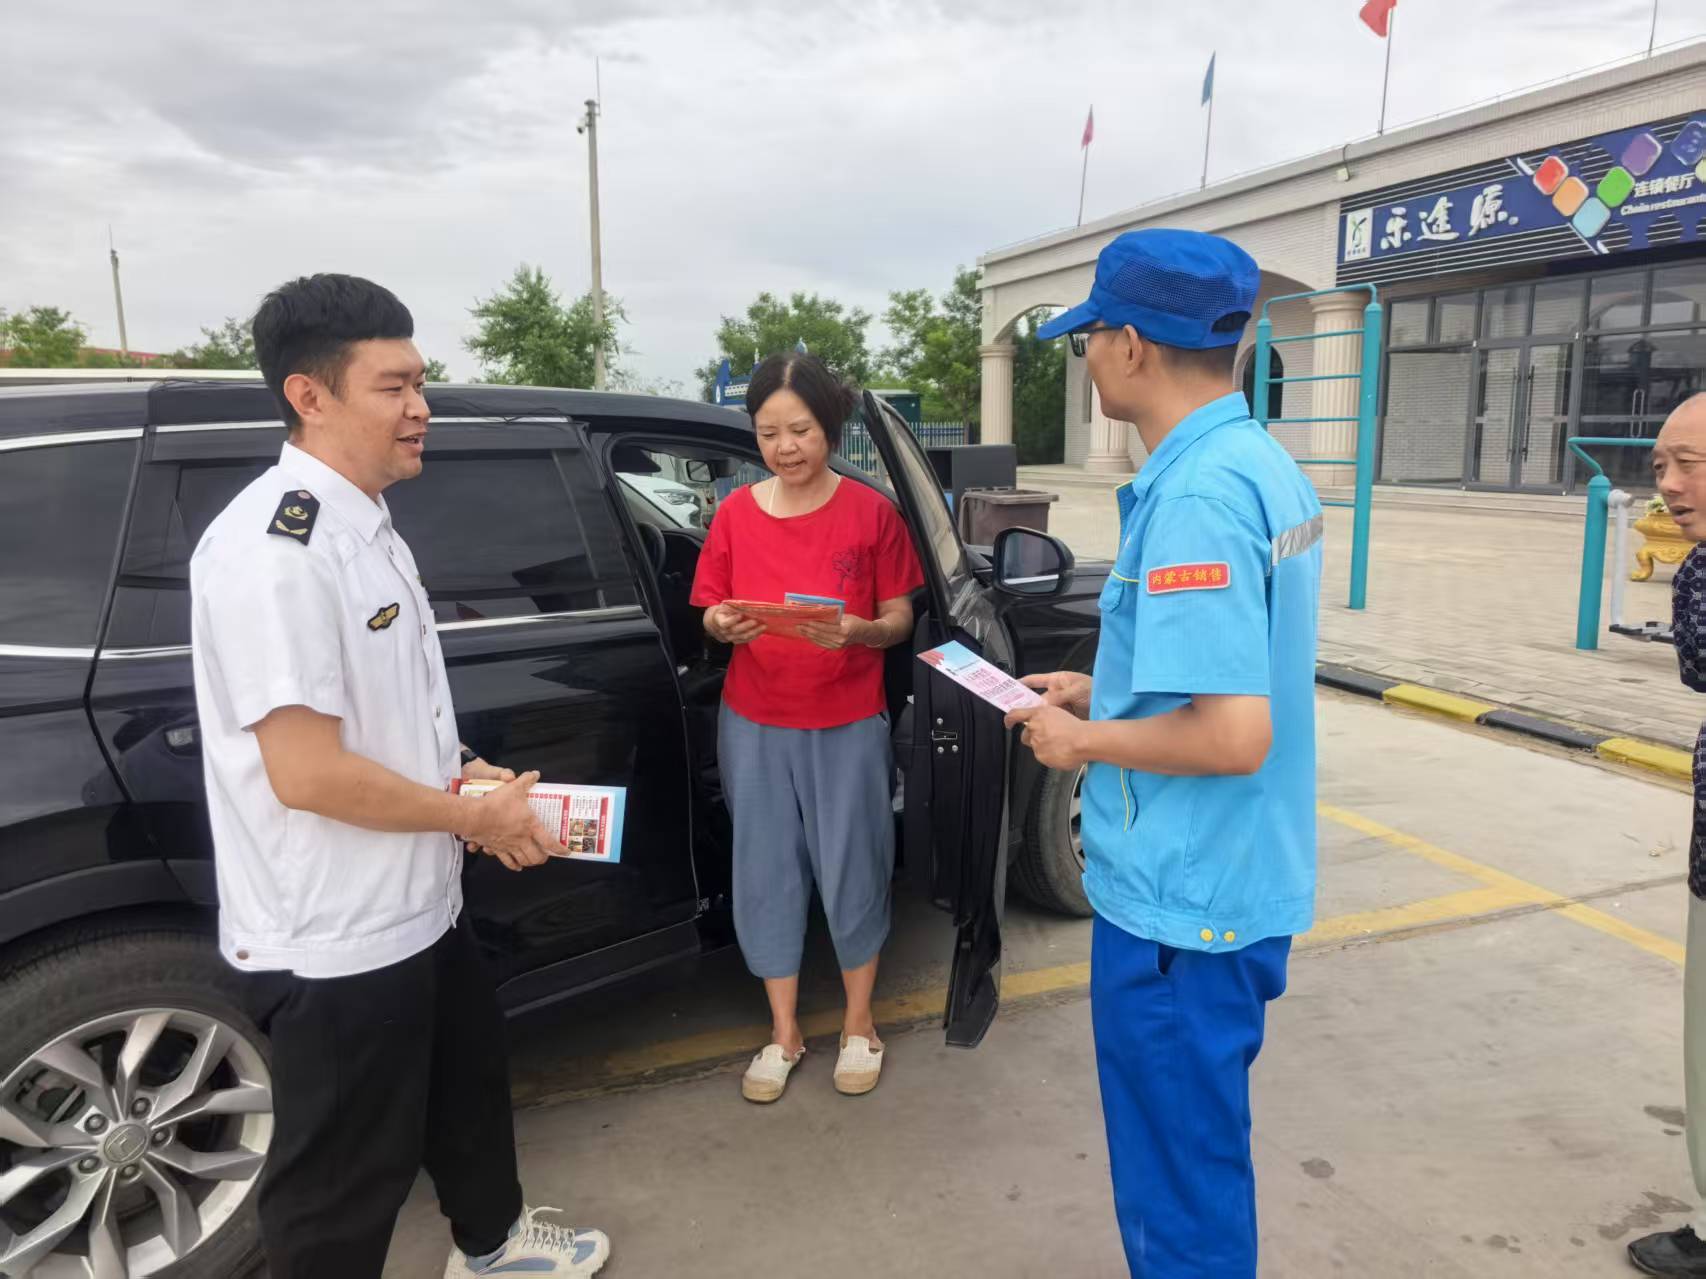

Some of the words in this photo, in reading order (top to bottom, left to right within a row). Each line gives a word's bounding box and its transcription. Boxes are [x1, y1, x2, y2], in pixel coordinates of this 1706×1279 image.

[1633, 172, 1696, 198] 连锁餐厅
[1152, 567, 1223, 585] 内蒙古销售
